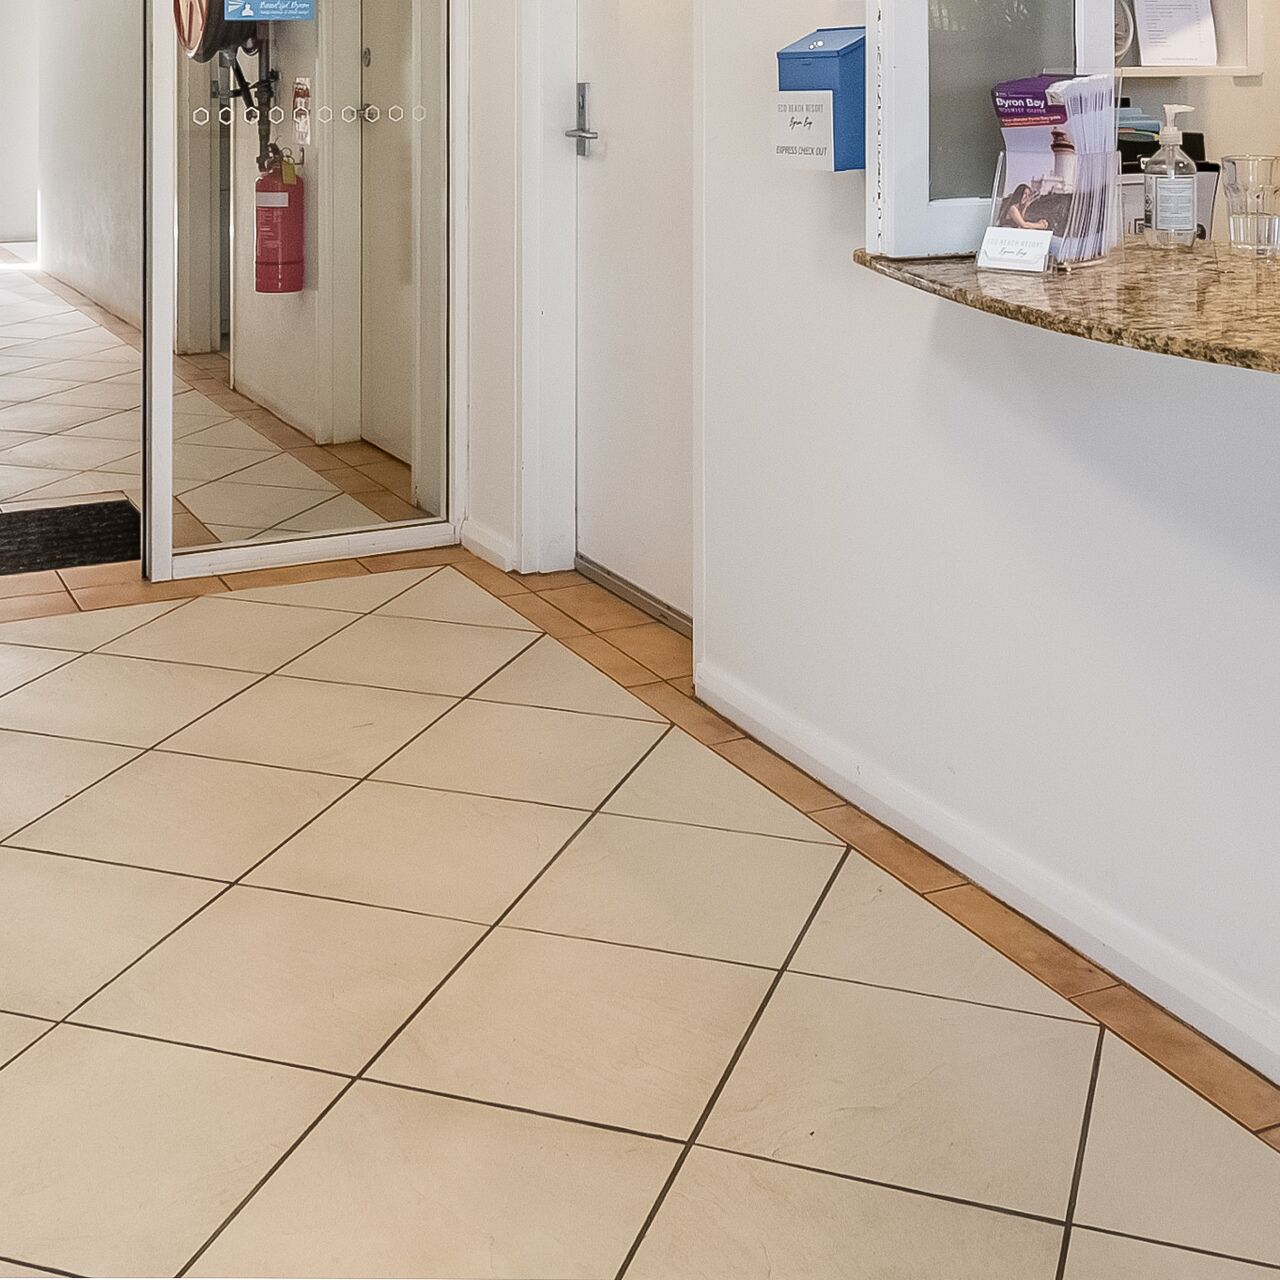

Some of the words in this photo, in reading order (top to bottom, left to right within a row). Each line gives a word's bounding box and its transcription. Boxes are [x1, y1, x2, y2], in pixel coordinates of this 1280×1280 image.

[996, 97, 1024, 107] Byron
[1026, 98, 1045, 109] Bay
[776, 146, 797, 155] EXPRESS
[815, 147, 827, 156] OUT
